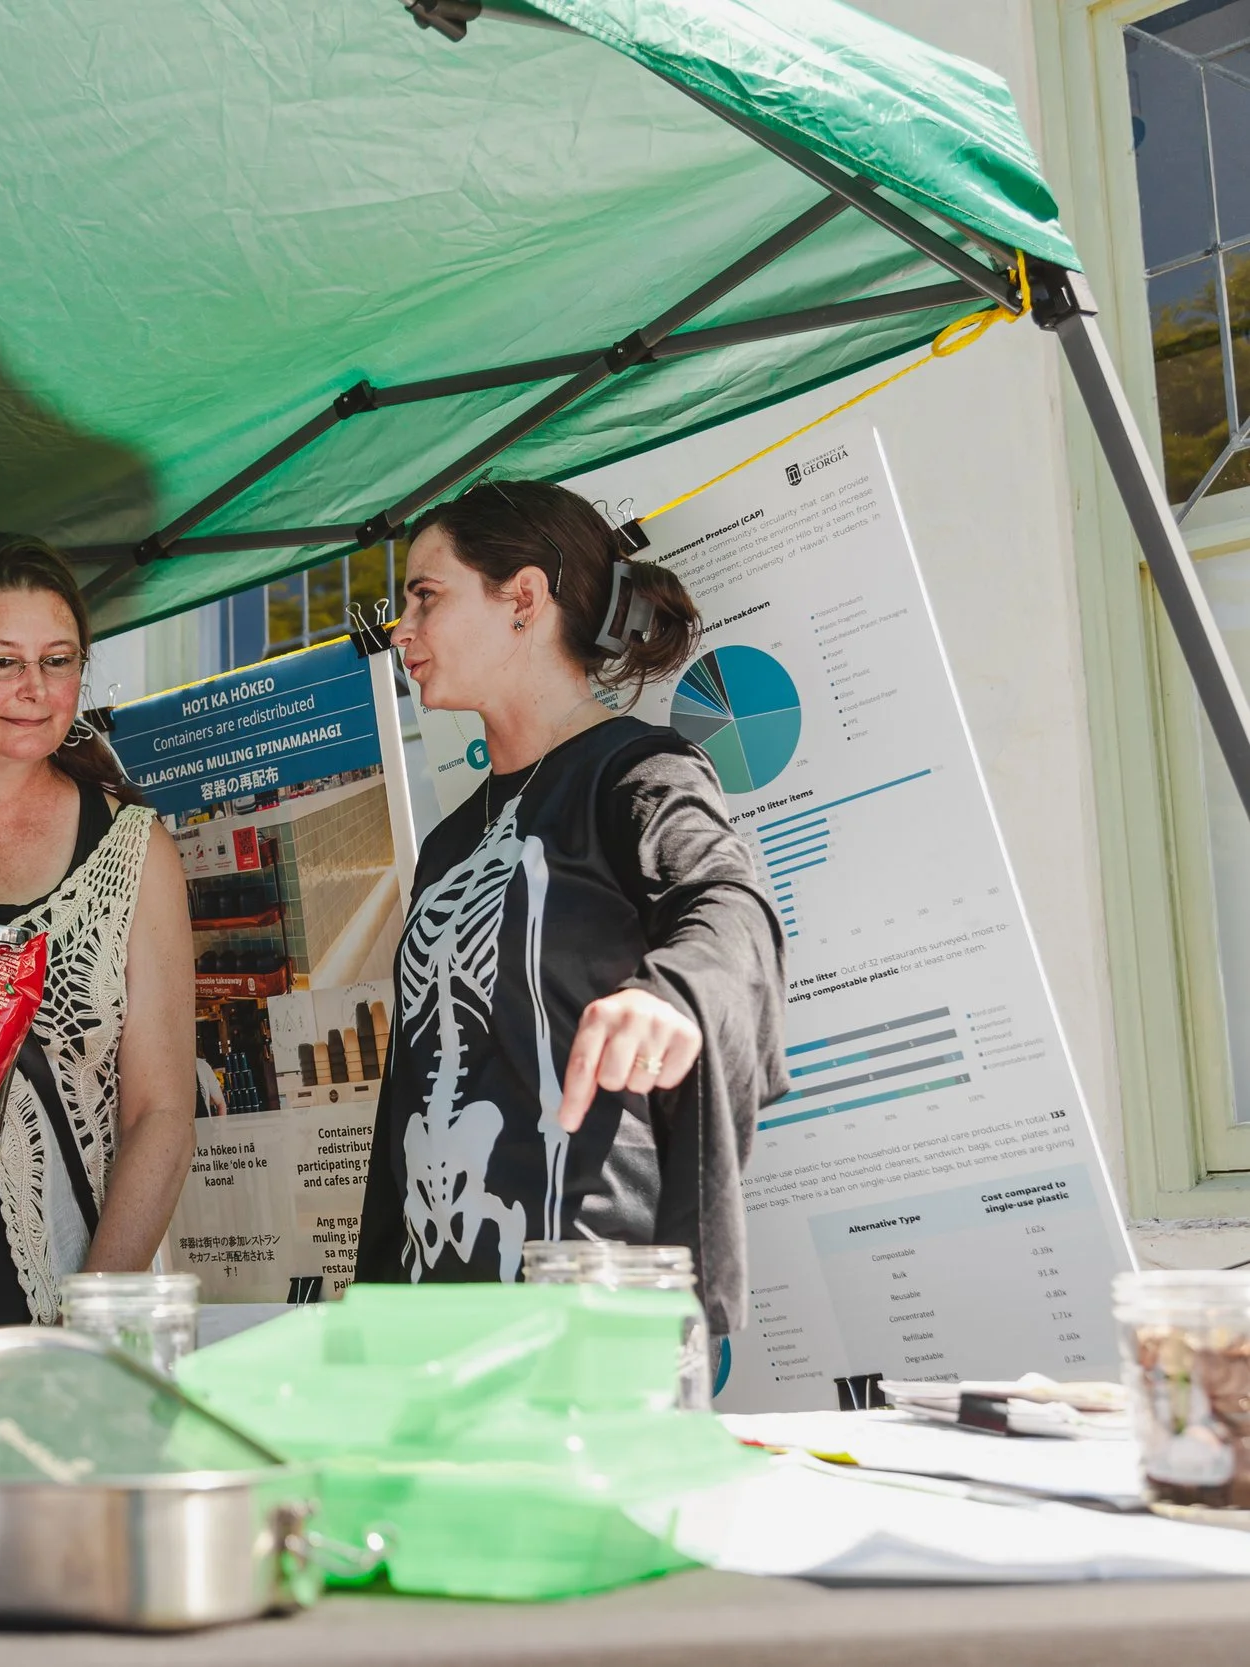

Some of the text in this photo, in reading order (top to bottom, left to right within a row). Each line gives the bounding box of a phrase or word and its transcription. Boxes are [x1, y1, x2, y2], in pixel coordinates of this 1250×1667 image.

[803, 450, 848, 475] GEORGIA
[690, 551, 698, 561] of
[759, 508, 797, 529] circularity
[799, 498, 816, 510] that
[820, 491, 835, 501] can
[838, 475, 868, 494] provide
[705, 488, 872, 567] of waste into the environment and increase
[658, 508, 764, 563] Assessment Protocol (CAP)
[742, 540, 784, 564] conducted
[795, 530, 812, 540] Hilo
[813, 524, 823, 532] by
[832, 510, 854, 524] team
[856, 500, 876, 513] from
[695, 582, 724, 598] Georgia
[727, 572, 742, 584] and
[745, 555, 783, 576] University
[787, 548, 795, 558] of
[832, 518, 868, 538] students
[723, 601, 770, 624] breakdown
[211, 691, 228, 707] KA
[230, 677, 274, 702] HŌKEO
[153, 693, 314, 751] Containers are redistributed
[206, 746, 253, 770] MULING
[255, 723, 342, 757] IPINAMAHAGI
[437, 757, 464, 772] COLLECTION
[200, 766, 278, 800] 容器の再配布
[741, 810, 755, 818] top
[766, 798, 787, 809] litter
[788, 789, 813, 802] items
[789, 980, 797, 989] of
[799, 978, 814, 986] the
[815, 971, 836, 981] litter
[840, 965, 857, 974] Out
[858, 960, 866, 970] of
[868, 958, 878, 967] 32
[880, 945, 927, 964] restaurants
[971, 926, 994, 937] most
[787, 992, 811, 1003] using
[812, 976, 867, 996] compostable
[869, 967, 898, 982] plastic
[900, 964, 911, 972] for
[923, 955, 944, 965] least
[945, 950, 962, 959] one
[318, 1125, 372, 1138] Containers
[197, 1146, 208, 1156] ka
[210, 1144, 237, 1155] hōkeo
[238, 1143, 241, 1153] i
[243, 1142, 255, 1153] nā
[754, 1170, 792, 1183] single-use
[794, 1164, 819, 1175] plastic
[833, 1156, 856, 1166] some
[856, 1145, 900, 1160] household
[912, 1134, 949, 1150] personal
[950, 1132, 969, 1141] care
[1049, 1109, 1066, 1119] 135
[212, 1160, 228, 1170] like
[247, 1160, 253, 1168] o
[255, 1157, 267, 1167] ke
[297, 1158, 361, 1175] participating
[763, 1181, 797, 1194] included
[799, 1178, 818, 1187] soap
[821, 1173, 836, 1182] and
[839, 1163, 882, 1177] household
[924, 1146, 964, 1160] sandwich
[1021, 1129, 1049, 1141] plates
[1052, 1124, 1070, 1133] and
[204, 1174, 234, 1186] kaona!
[303, 1174, 350, 1187] and cafes
[745, 1202, 767, 1213] paper
[791, 1192, 813, 1201] There
[829, 1185, 845, 1194] ban
[859, 1174, 901, 1188] single-use
[903, 1168, 930, 1179] plastic
[956, 1159, 972, 1168] but
[973, 1154, 998, 1164] some
[1000, 1148, 1027, 1159] stores
[1045, 1138, 1074, 1152] giving
[981, 1193, 1002, 1202] Cost
[1004, 1182, 1053, 1197] compared
[985, 1191, 1069, 1213] single-use plastic
[316, 1216, 357, 1229] Ang mga
[849, 1215, 920, 1233] Alternative Type
[312, 1231, 346, 1244] muling
[324, 1249, 335, 1258] sa
[871, 1248, 915, 1261] Compostable
[891, 1271, 907, 1279] Bulk
[890, 1291, 920, 1300] Reusable
[889, 1309, 934, 1322] Concentrated
[902, 1332, 933, 1342] Refillable
[904, 1352, 943, 1363] Degradable
